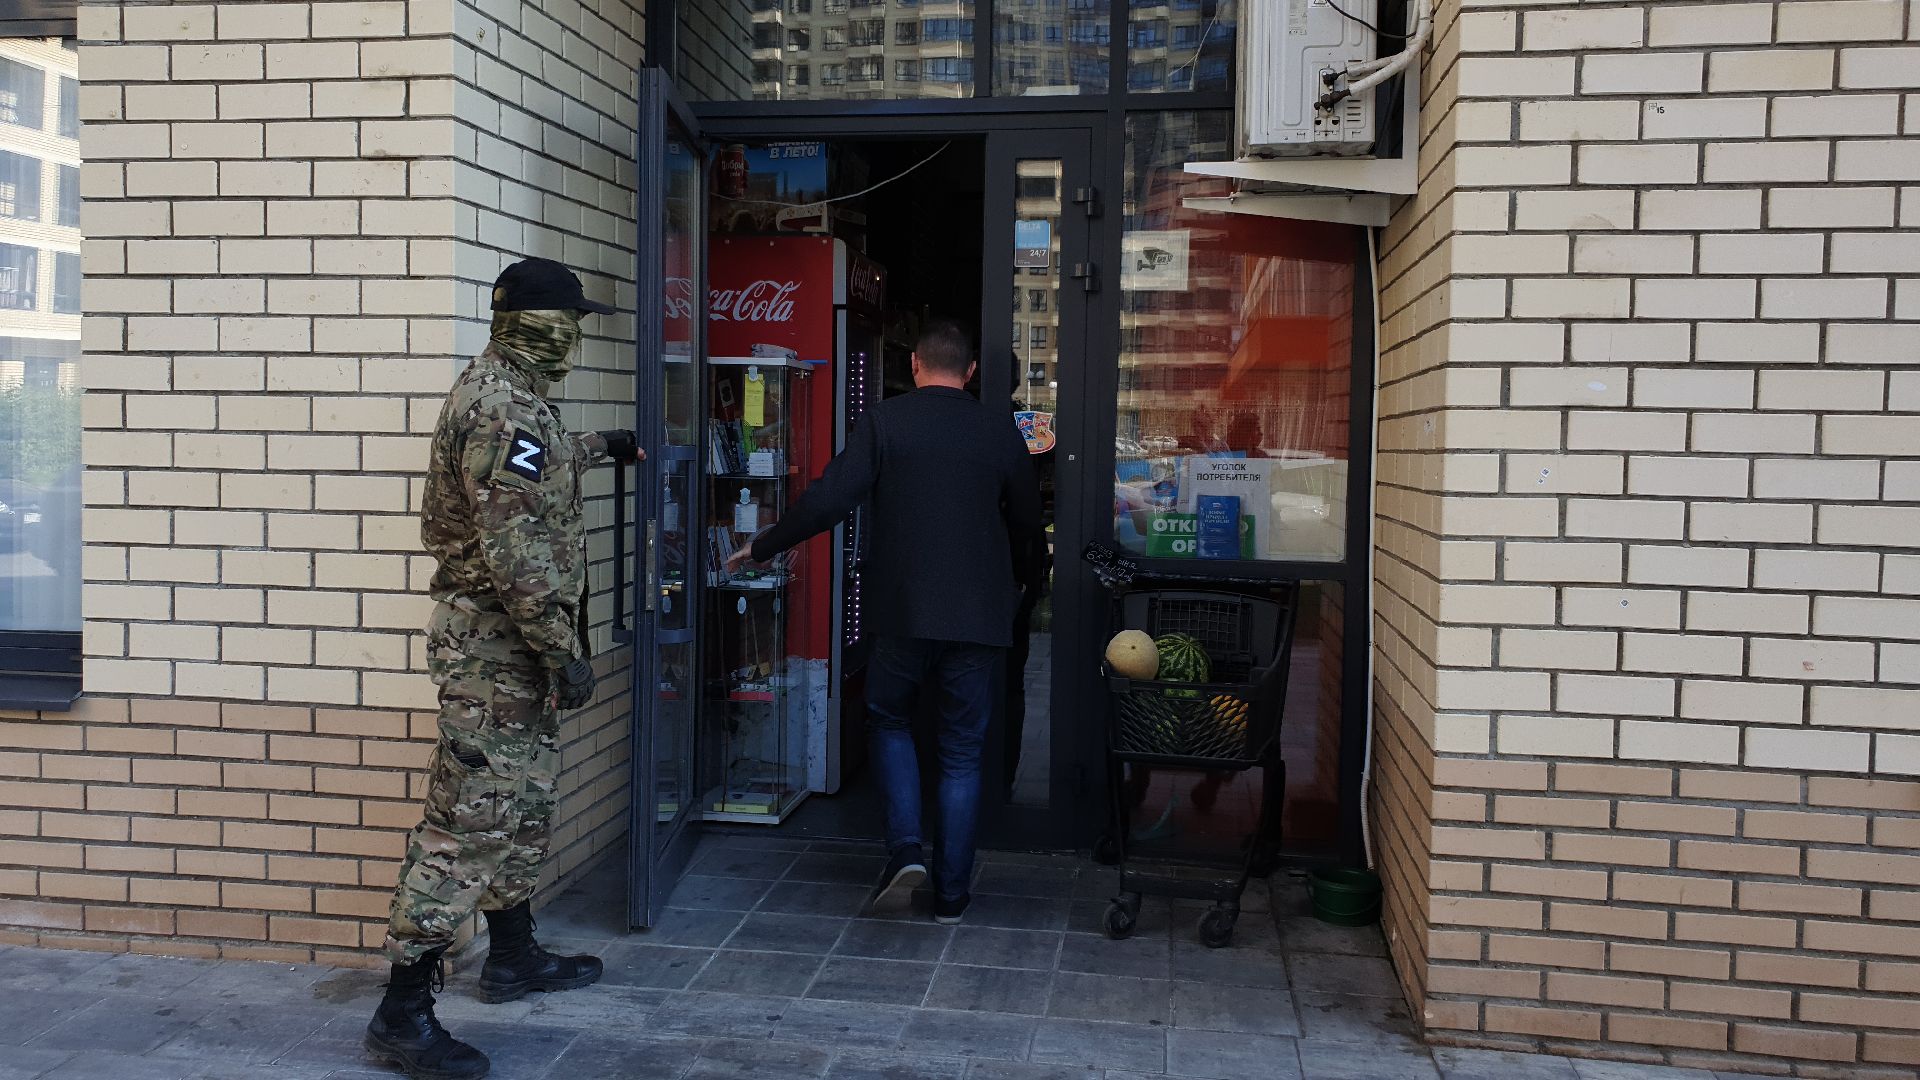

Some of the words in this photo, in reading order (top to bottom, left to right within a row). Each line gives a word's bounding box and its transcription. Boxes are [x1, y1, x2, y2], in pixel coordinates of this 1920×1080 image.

[769, 147, 780, 159] В
[783, 145, 819, 158] ЛЕТО!
[709, 279, 802, 321] ca-Cola
[511, 439, 541, 472] Z
[1211, 463, 1247, 471] УГОЛОК
[1196, 473, 1261, 482] ПОТРЕБИТЕЛЯ
